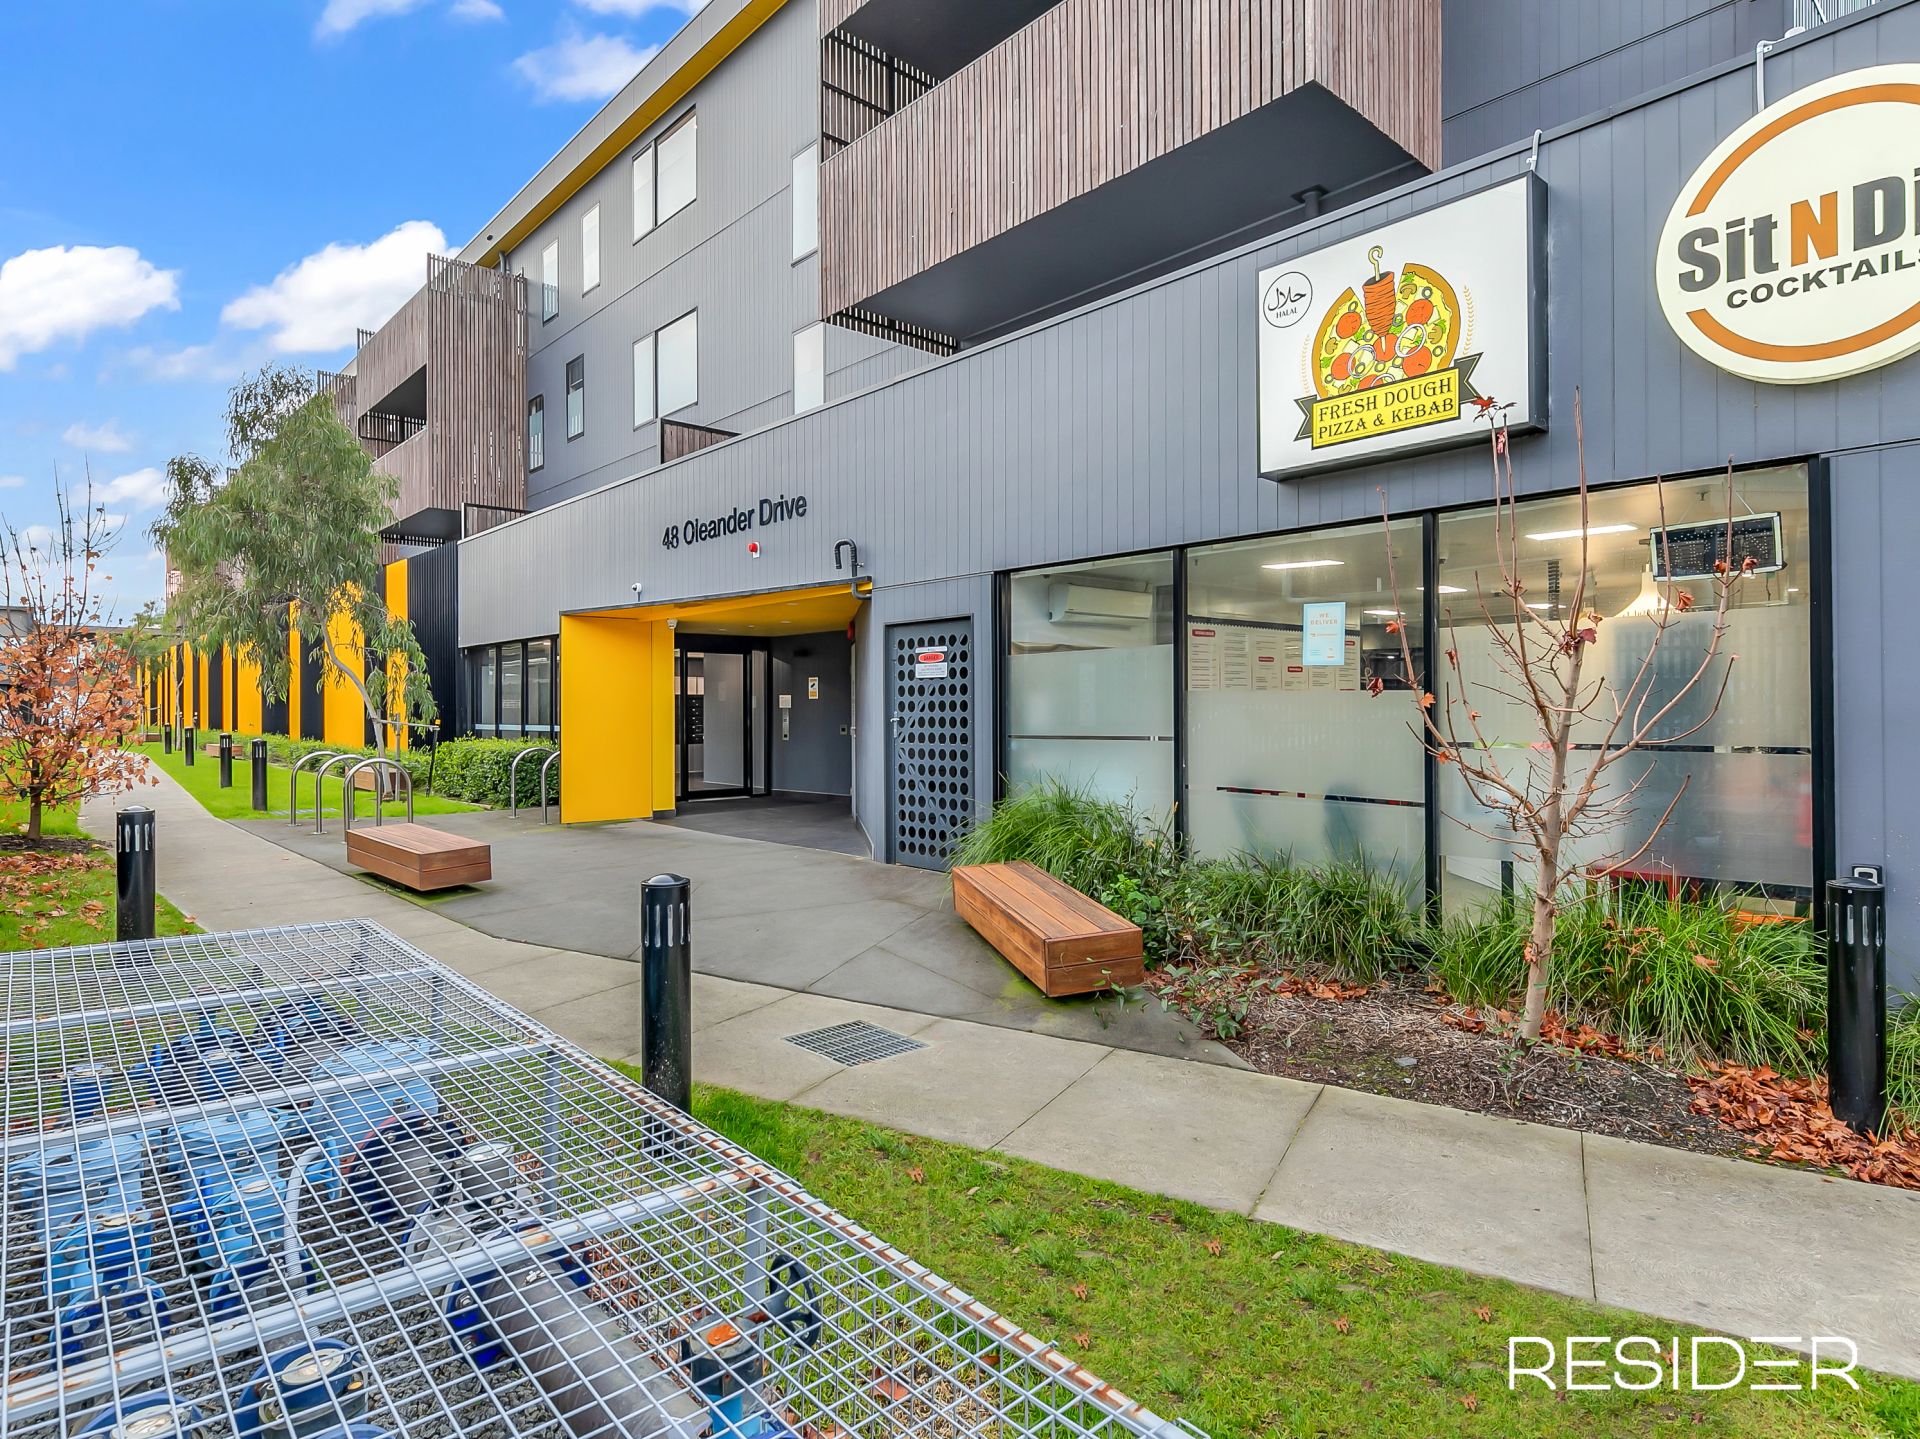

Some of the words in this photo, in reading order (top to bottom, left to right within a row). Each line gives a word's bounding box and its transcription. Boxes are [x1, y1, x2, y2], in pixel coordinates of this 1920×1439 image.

[1726, 247, 1920, 309] COCKTAIL
[1275, 306, 1298, 319] HALAL
[1318, 417, 1367, 440] PIZZA
[1373, 413, 1386, 427] &
[1391, 397, 1454, 424] KEBAB
[1319, 395, 1378, 422] FRESH
[1384, 376, 1452, 407] DOUGH
[662, 525, 680, 550] 48
[683, 507, 755, 545] Oleander
[759, 494, 808, 527] Drive
